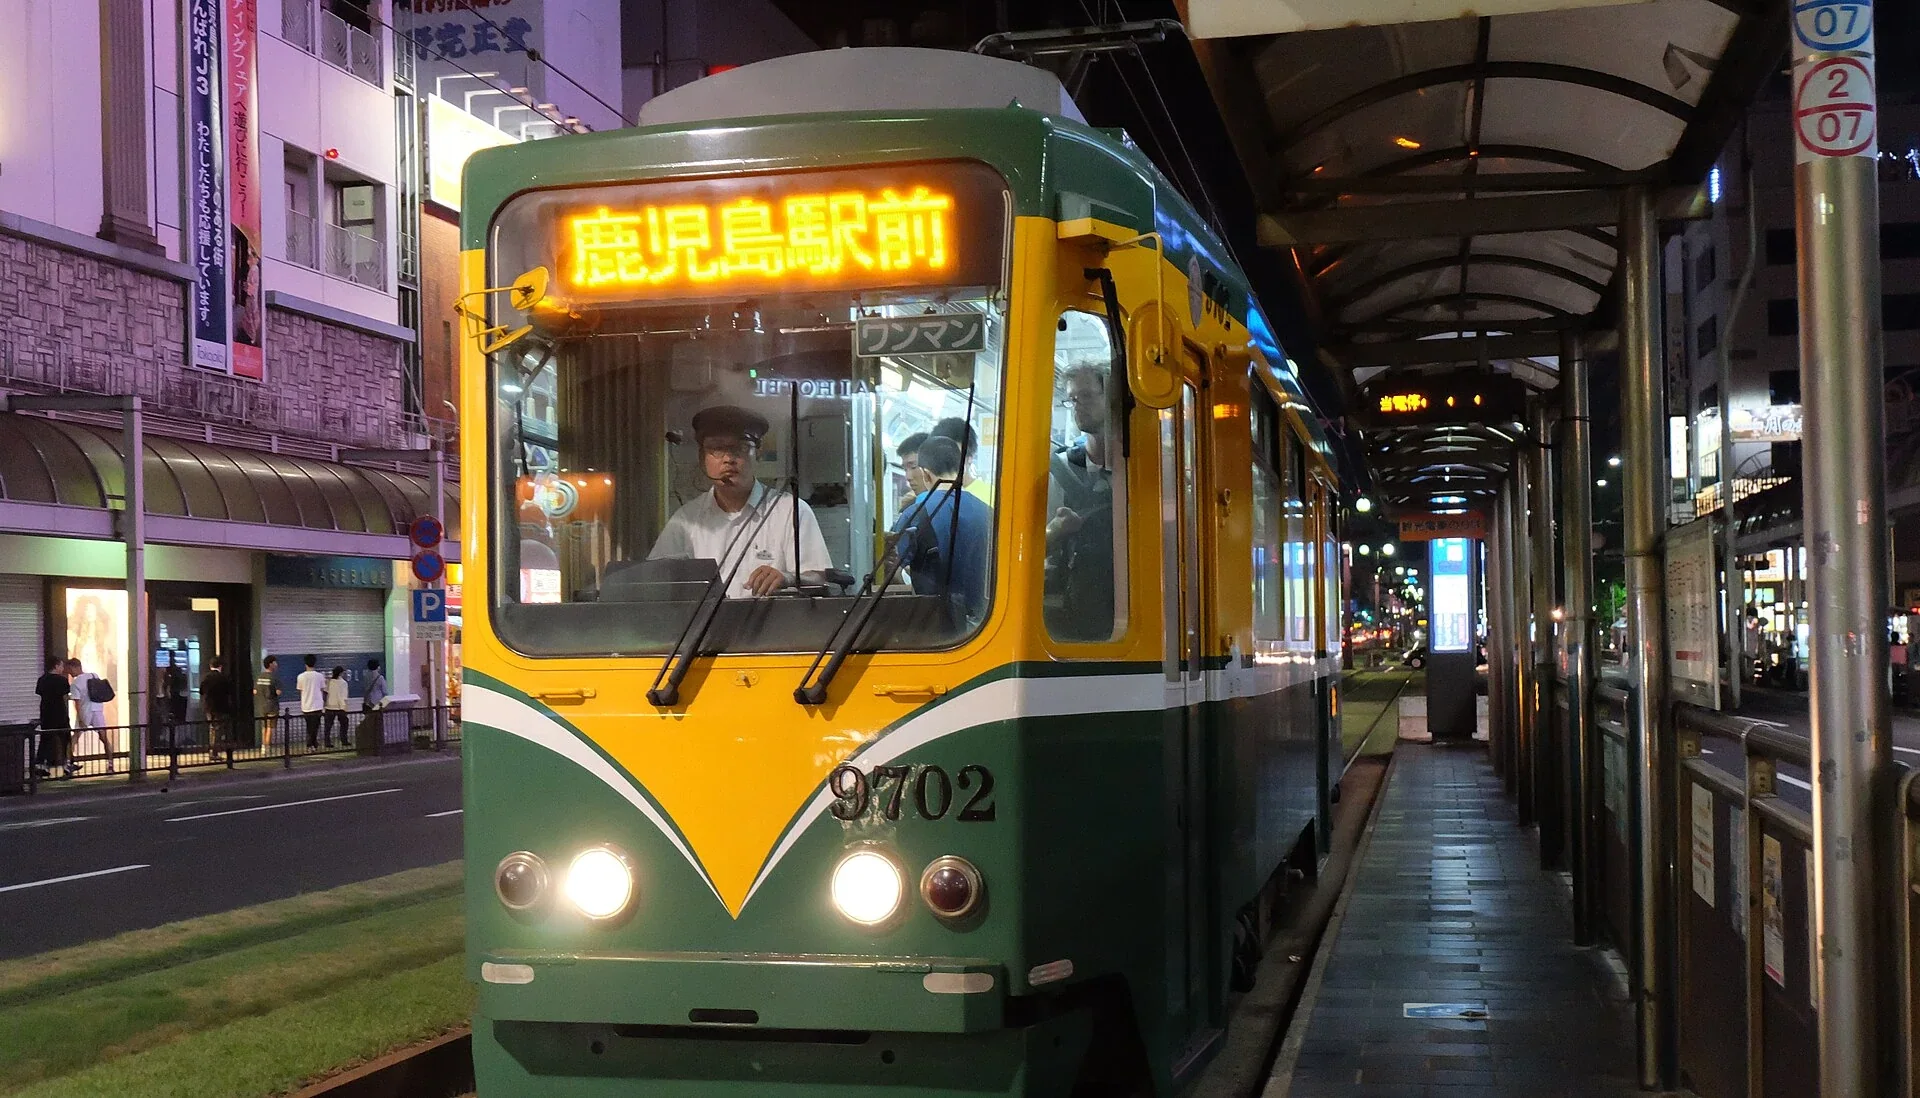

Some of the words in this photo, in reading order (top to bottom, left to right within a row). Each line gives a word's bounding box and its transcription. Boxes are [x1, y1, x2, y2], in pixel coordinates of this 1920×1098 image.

[1814, 5, 1858, 37] 07
[1827, 68, 1849, 98] 2
[1817, 111, 1861, 142] 07
[571, 185, 950, 286] 鹿児島駅前
[862, 319, 978, 352] ワンマン
[421, 592, 441, 619] P
[829, 765, 996, 822] 9702
